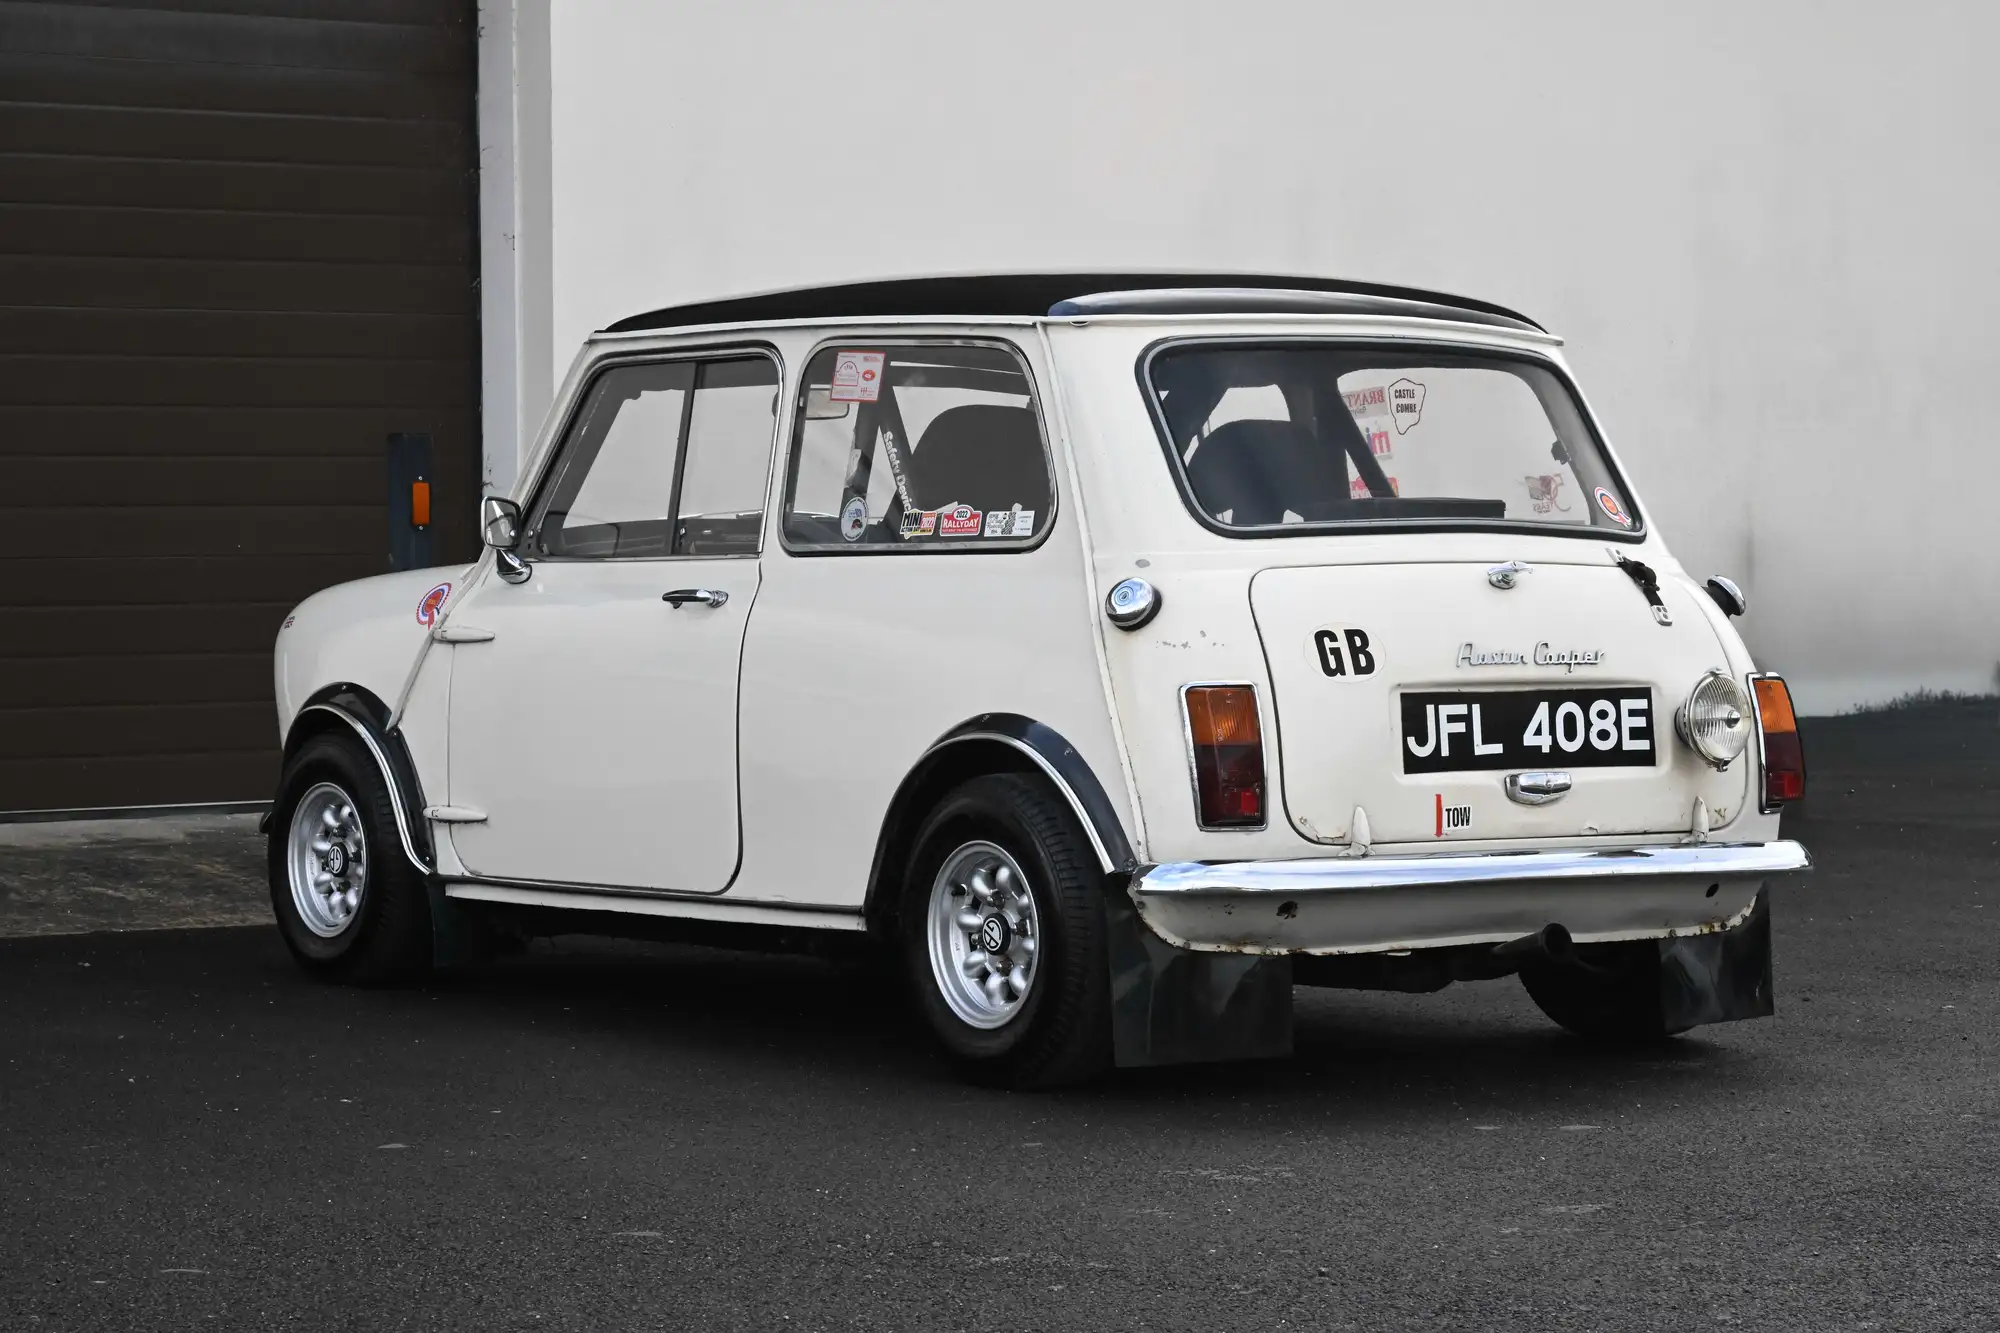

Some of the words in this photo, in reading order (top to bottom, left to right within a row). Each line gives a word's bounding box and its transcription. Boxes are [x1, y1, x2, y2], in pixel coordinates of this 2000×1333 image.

[1394, 389, 1415, 399] CASTLE
[1396, 403, 1417, 413] COMBE
[884, 431, 900, 474] Safety
[896, 474, 912, 512] Devic
[902, 512, 924, 527] MINI
[943, 517, 979, 528] RALLYDAY
[956, 510, 968, 519] 2022
[1313, 628, 1376, 677] GB
[1456, 643, 1528, 668] Austin
[1534, 640, 1605, 673] Cooper
[1406, 703, 1504, 758] JFL
[1523, 698, 1651, 754] 408E
[1445, 805, 1472, 828] TOW
